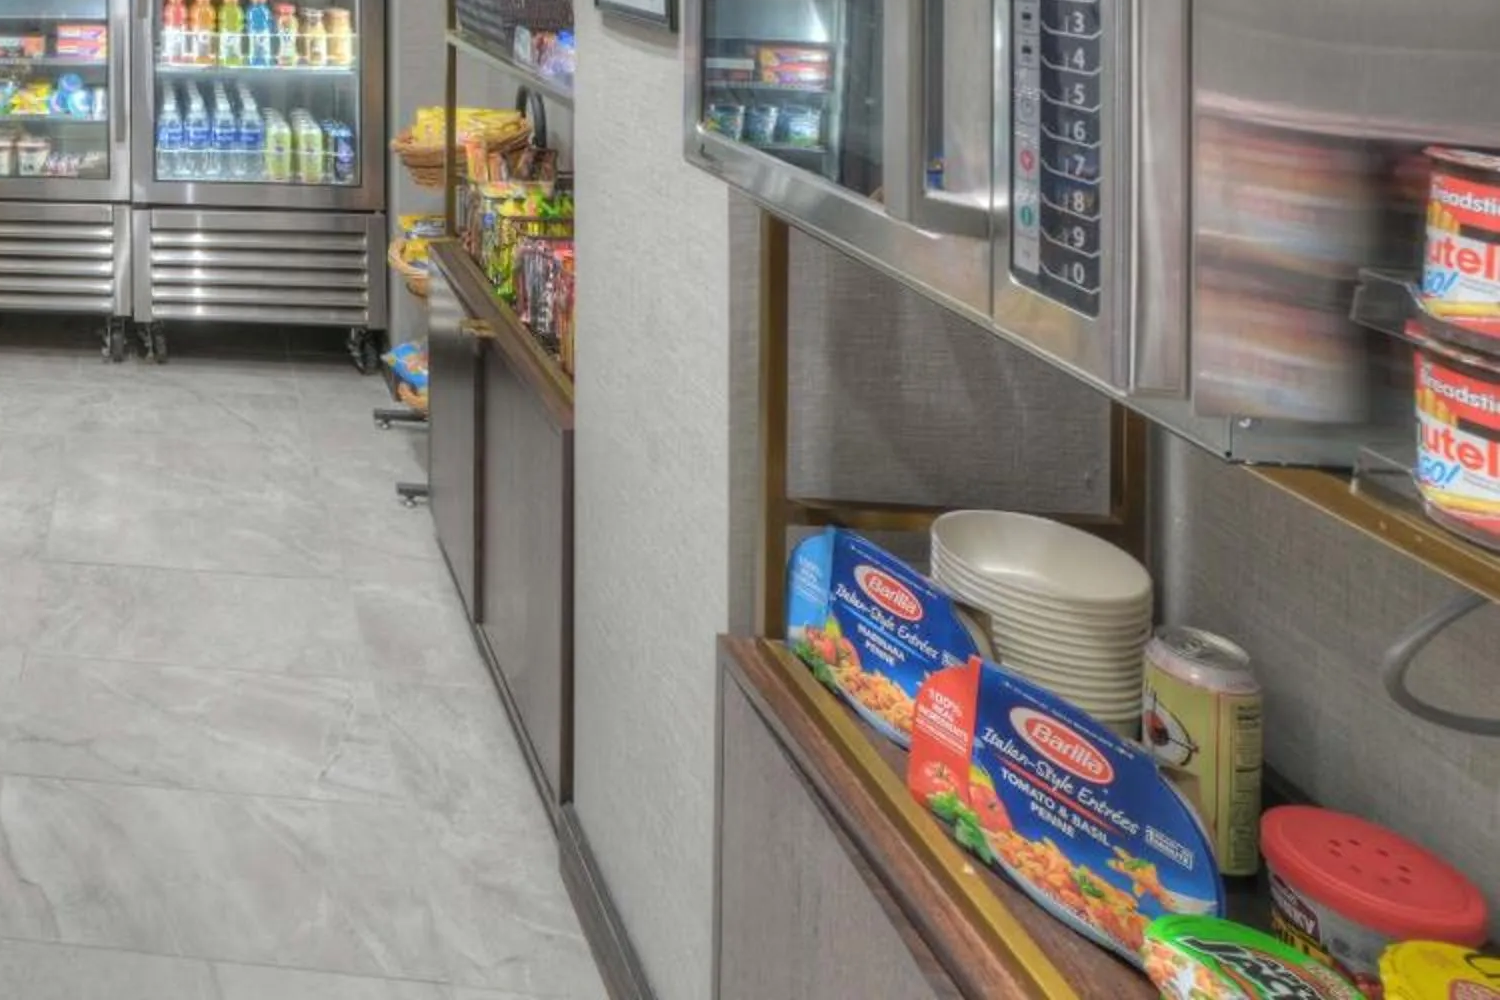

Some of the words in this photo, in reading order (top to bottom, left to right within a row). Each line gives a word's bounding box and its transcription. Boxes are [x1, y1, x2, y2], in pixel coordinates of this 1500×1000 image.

[1074, 11, 1085, 32] 3
[1074, 46, 1085, 68] 4
[1074, 83, 1085, 105] 5
[1074, 119, 1085, 141] 6
[1074, 154, 1085, 176] 7
[1074, 191, 1085, 213] 8
[1074, 226, 1085, 248] 9
[1074, 262, 1085, 285] 0
[867, 573, 918, 615] Barilla
[1030, 721, 1103, 777] Barilla
[980, 726, 1075, 796] Italian-Style
[1076, 783, 1141, 836] Entrées
[1001, 767, 1057, 812] TOMATO
[1070, 811, 1111, 848] BASIL
[1029, 800, 1076, 839] PENNE
